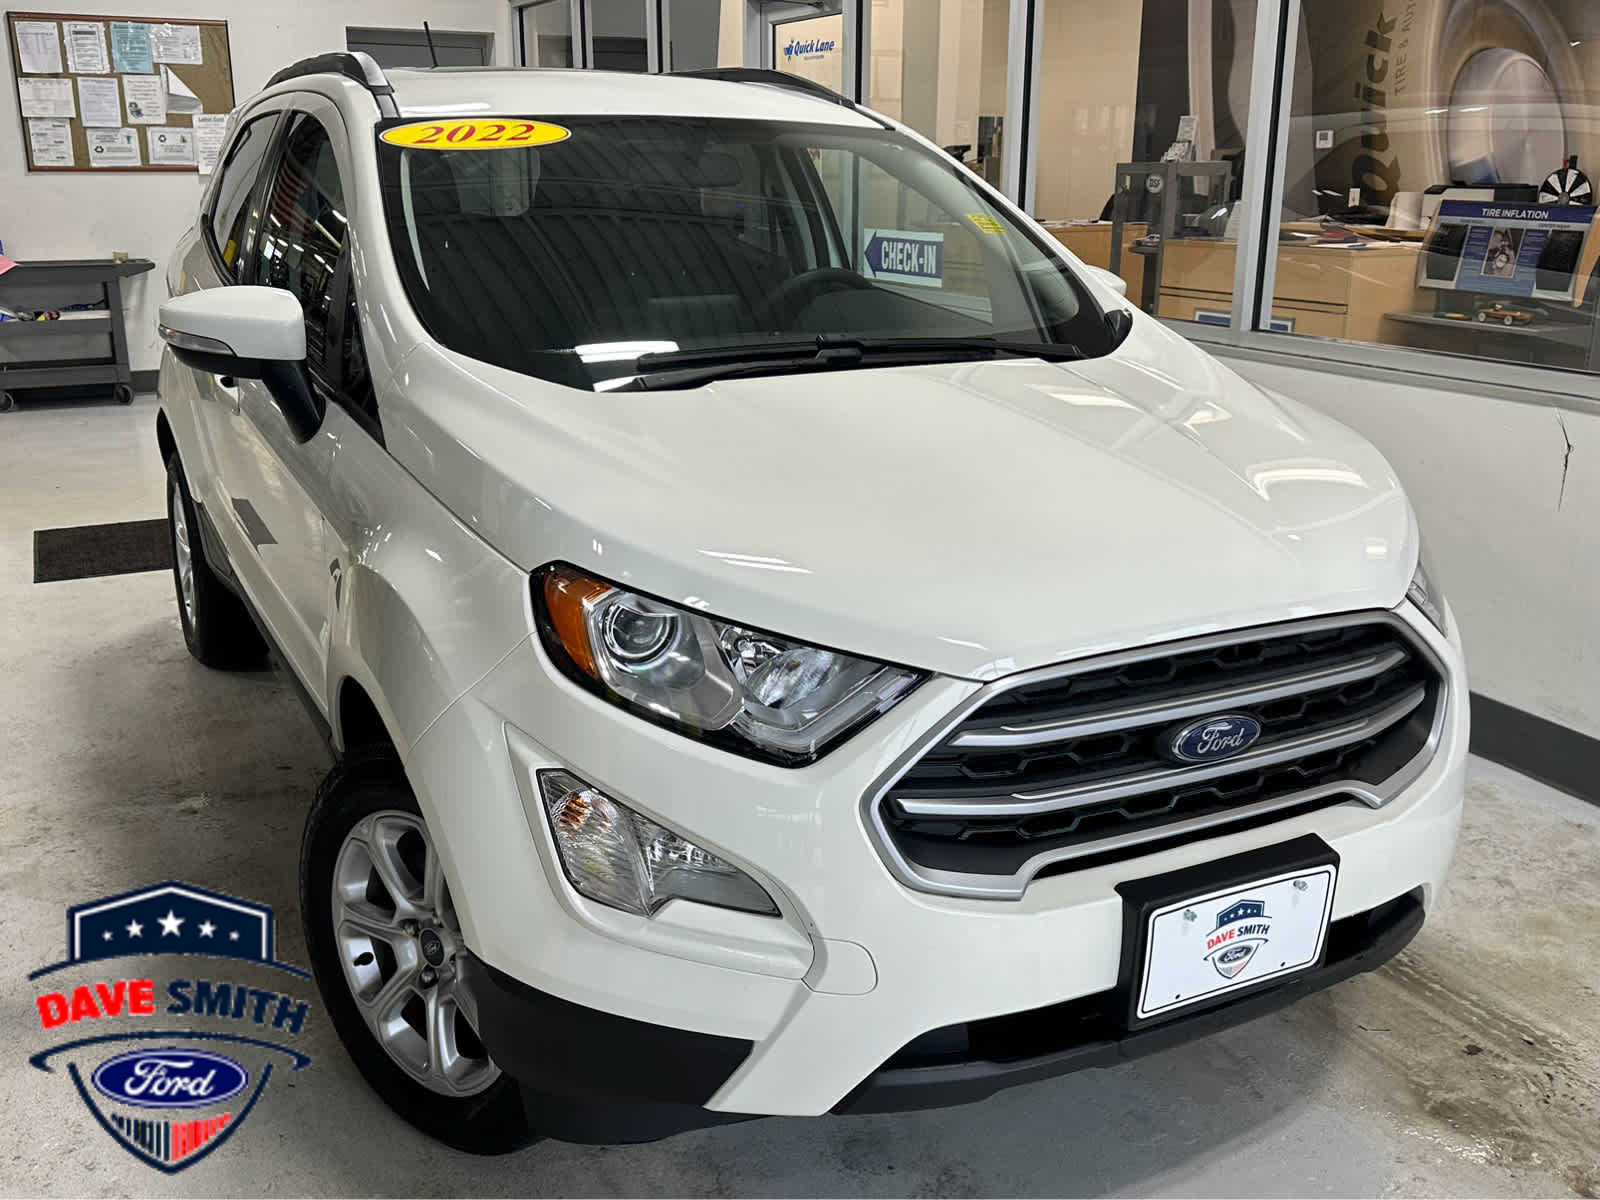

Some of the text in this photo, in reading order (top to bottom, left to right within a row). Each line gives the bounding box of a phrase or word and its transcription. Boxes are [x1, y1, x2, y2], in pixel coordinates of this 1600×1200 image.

[794, 39, 835, 56] Quick Lane
[1394, 52, 1408, 96] TIRE
[414, 123, 535, 144] 2022
[1481, 207, 1549, 220] TIRE INFLATION
[881, 240, 937, 274] CHECK-IN
[1197, 722, 1245, 754] Ford
[1207, 924, 1270, 950] DAVE SMITH
